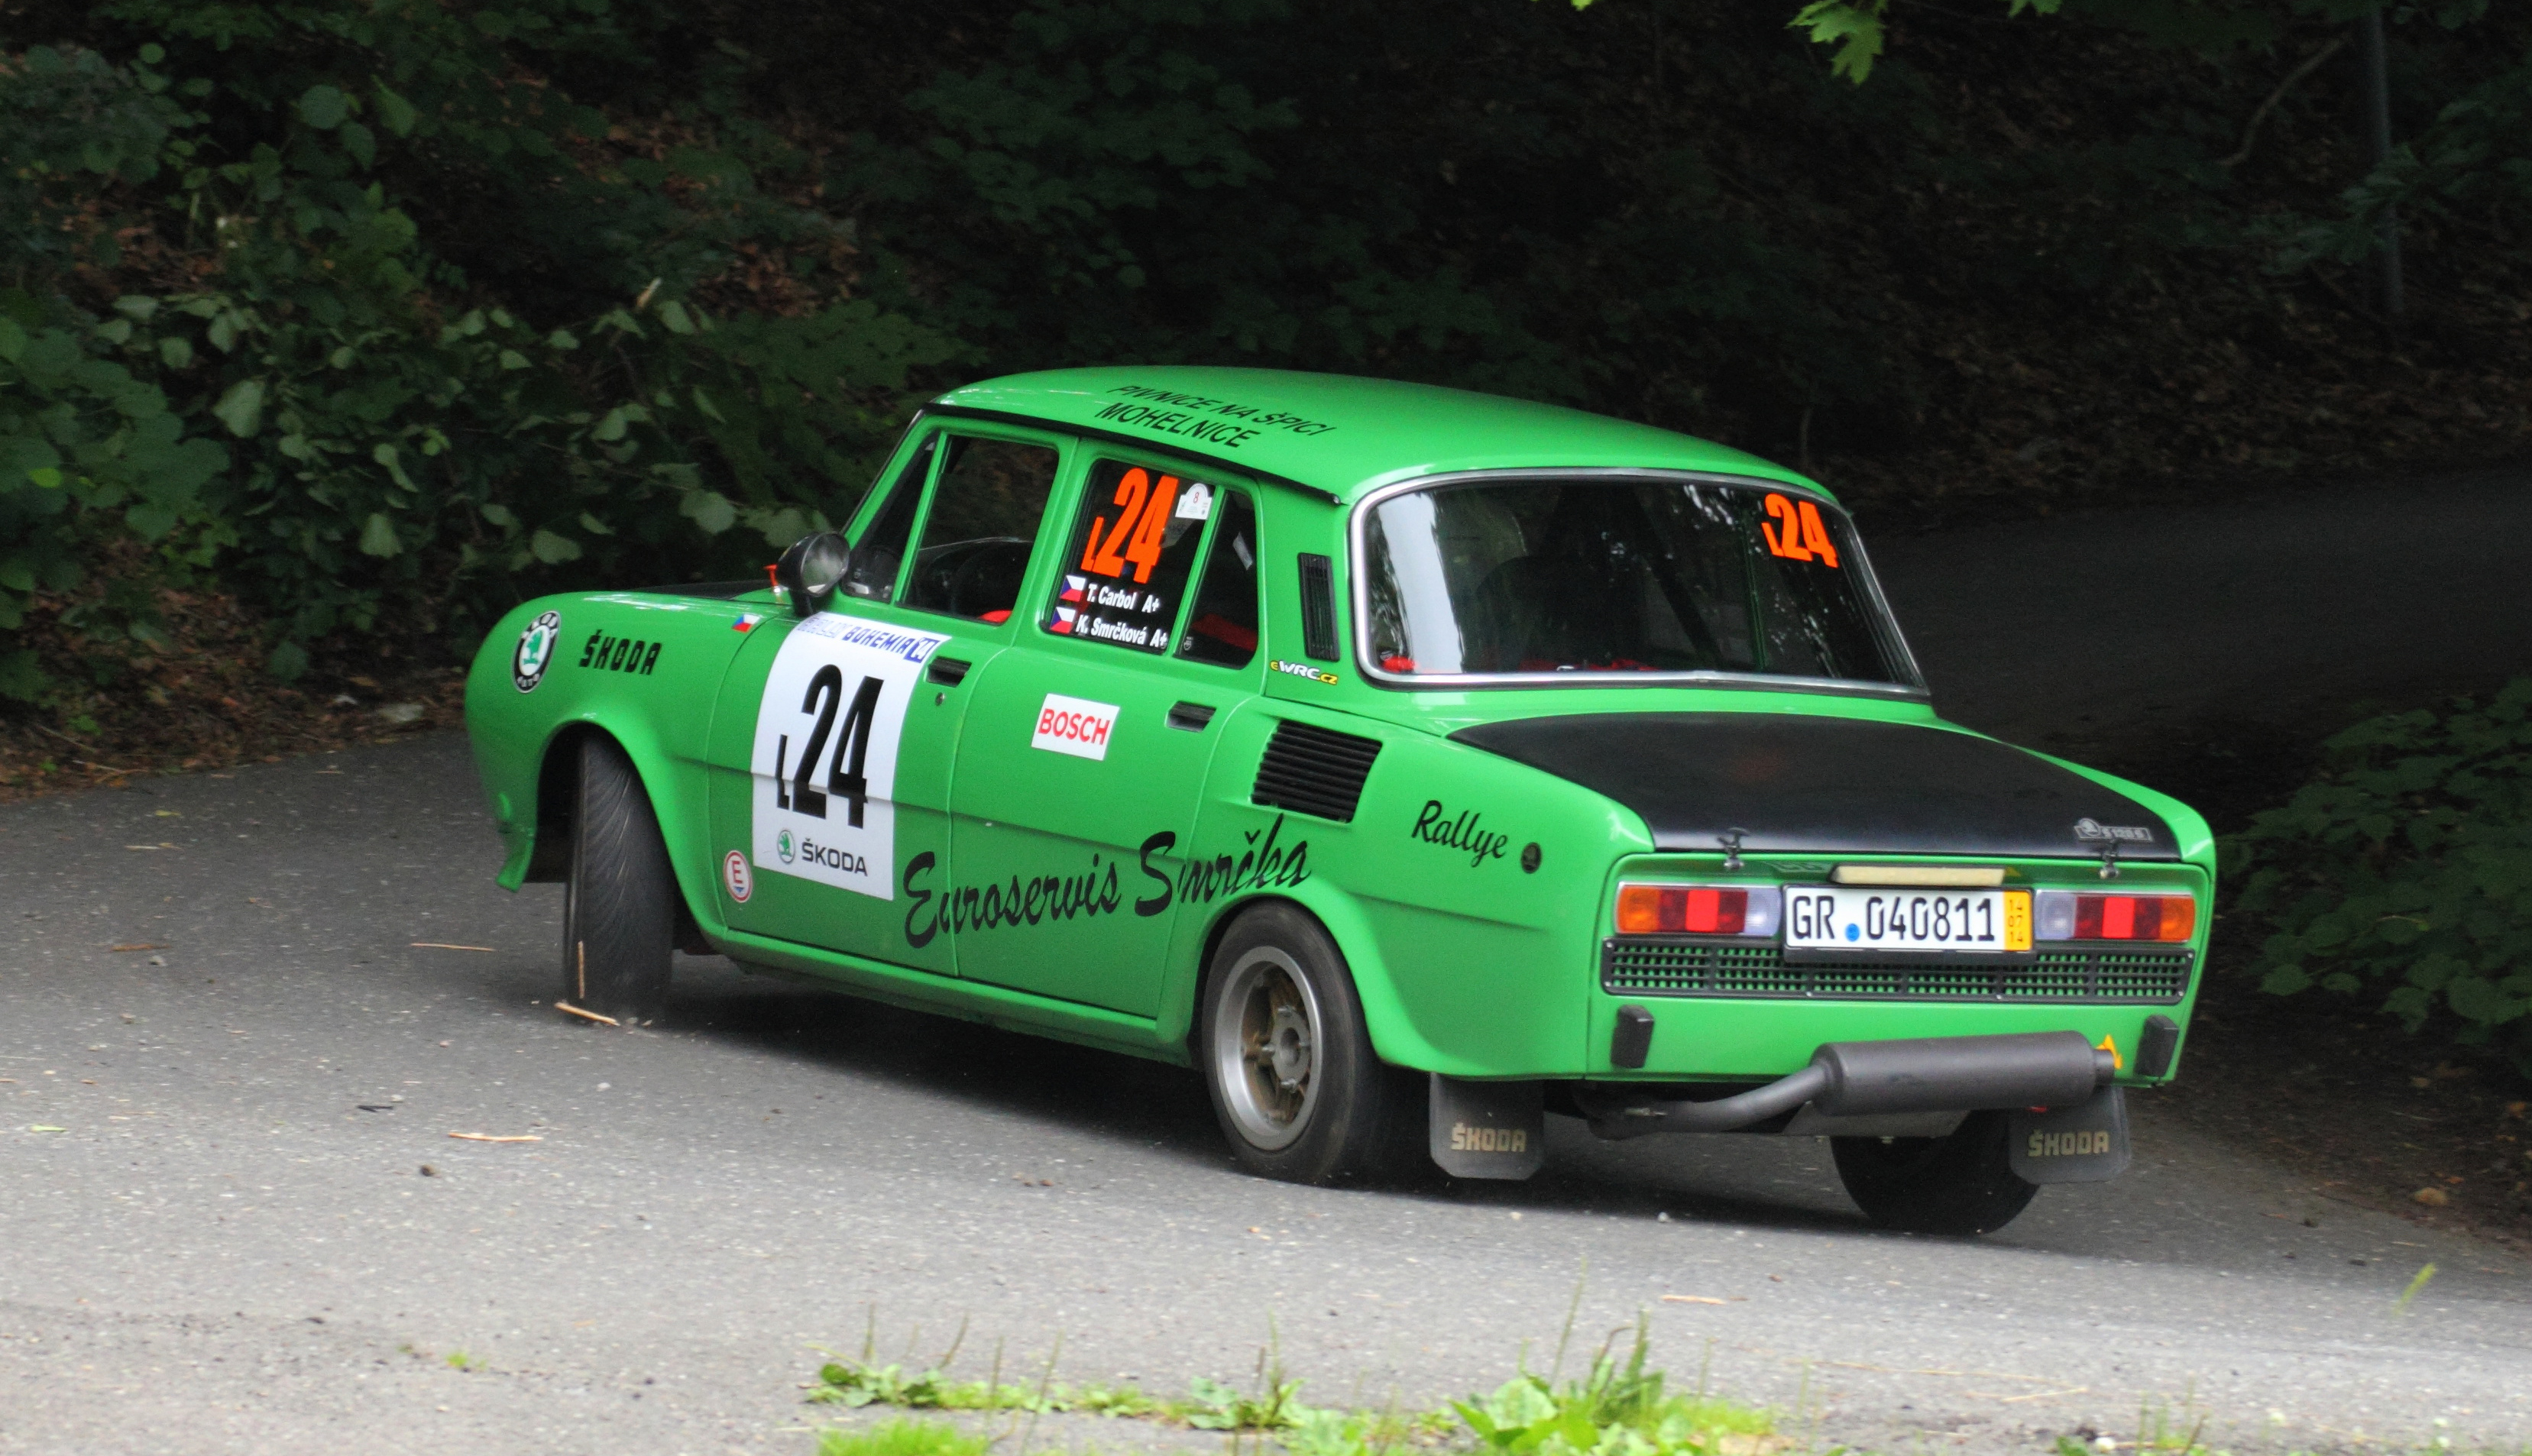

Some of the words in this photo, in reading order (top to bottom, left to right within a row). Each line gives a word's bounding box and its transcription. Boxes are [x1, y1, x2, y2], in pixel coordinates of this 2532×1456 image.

[1094, 403, 1261, 448] MOHELNICE
[1106, 386, 1223, 409] PIVNICE
[1208, 404, 1260, 419] NA
[1251, 412, 1336, 435] ŠPICI
[1086, 583, 1098, 603] T.
[1098, 586, 1138, 610] Carbol
[841, 626, 916, 655] BOHEMIA
[1075, 614, 1090, 634] K.
[1091, 617, 1148, 645] Smrčková
[1038, 707, 1110, 746] BOSCH
[1411, 800, 1508, 868] Rallye
[731, 860, 743, 884] E
[801, 837, 868, 877] ŠKODA
[903, 851, 1122, 949] Euroservis
[1135, 813, 1312, 917] Smrčka
[1792, 895, 1835, 940] GR
[1866, 896, 1995, 942] 040811
[1451, 1122, 1527, 1153] ŠKODA
[2028, 1128, 2109, 1157] ŠKODA
